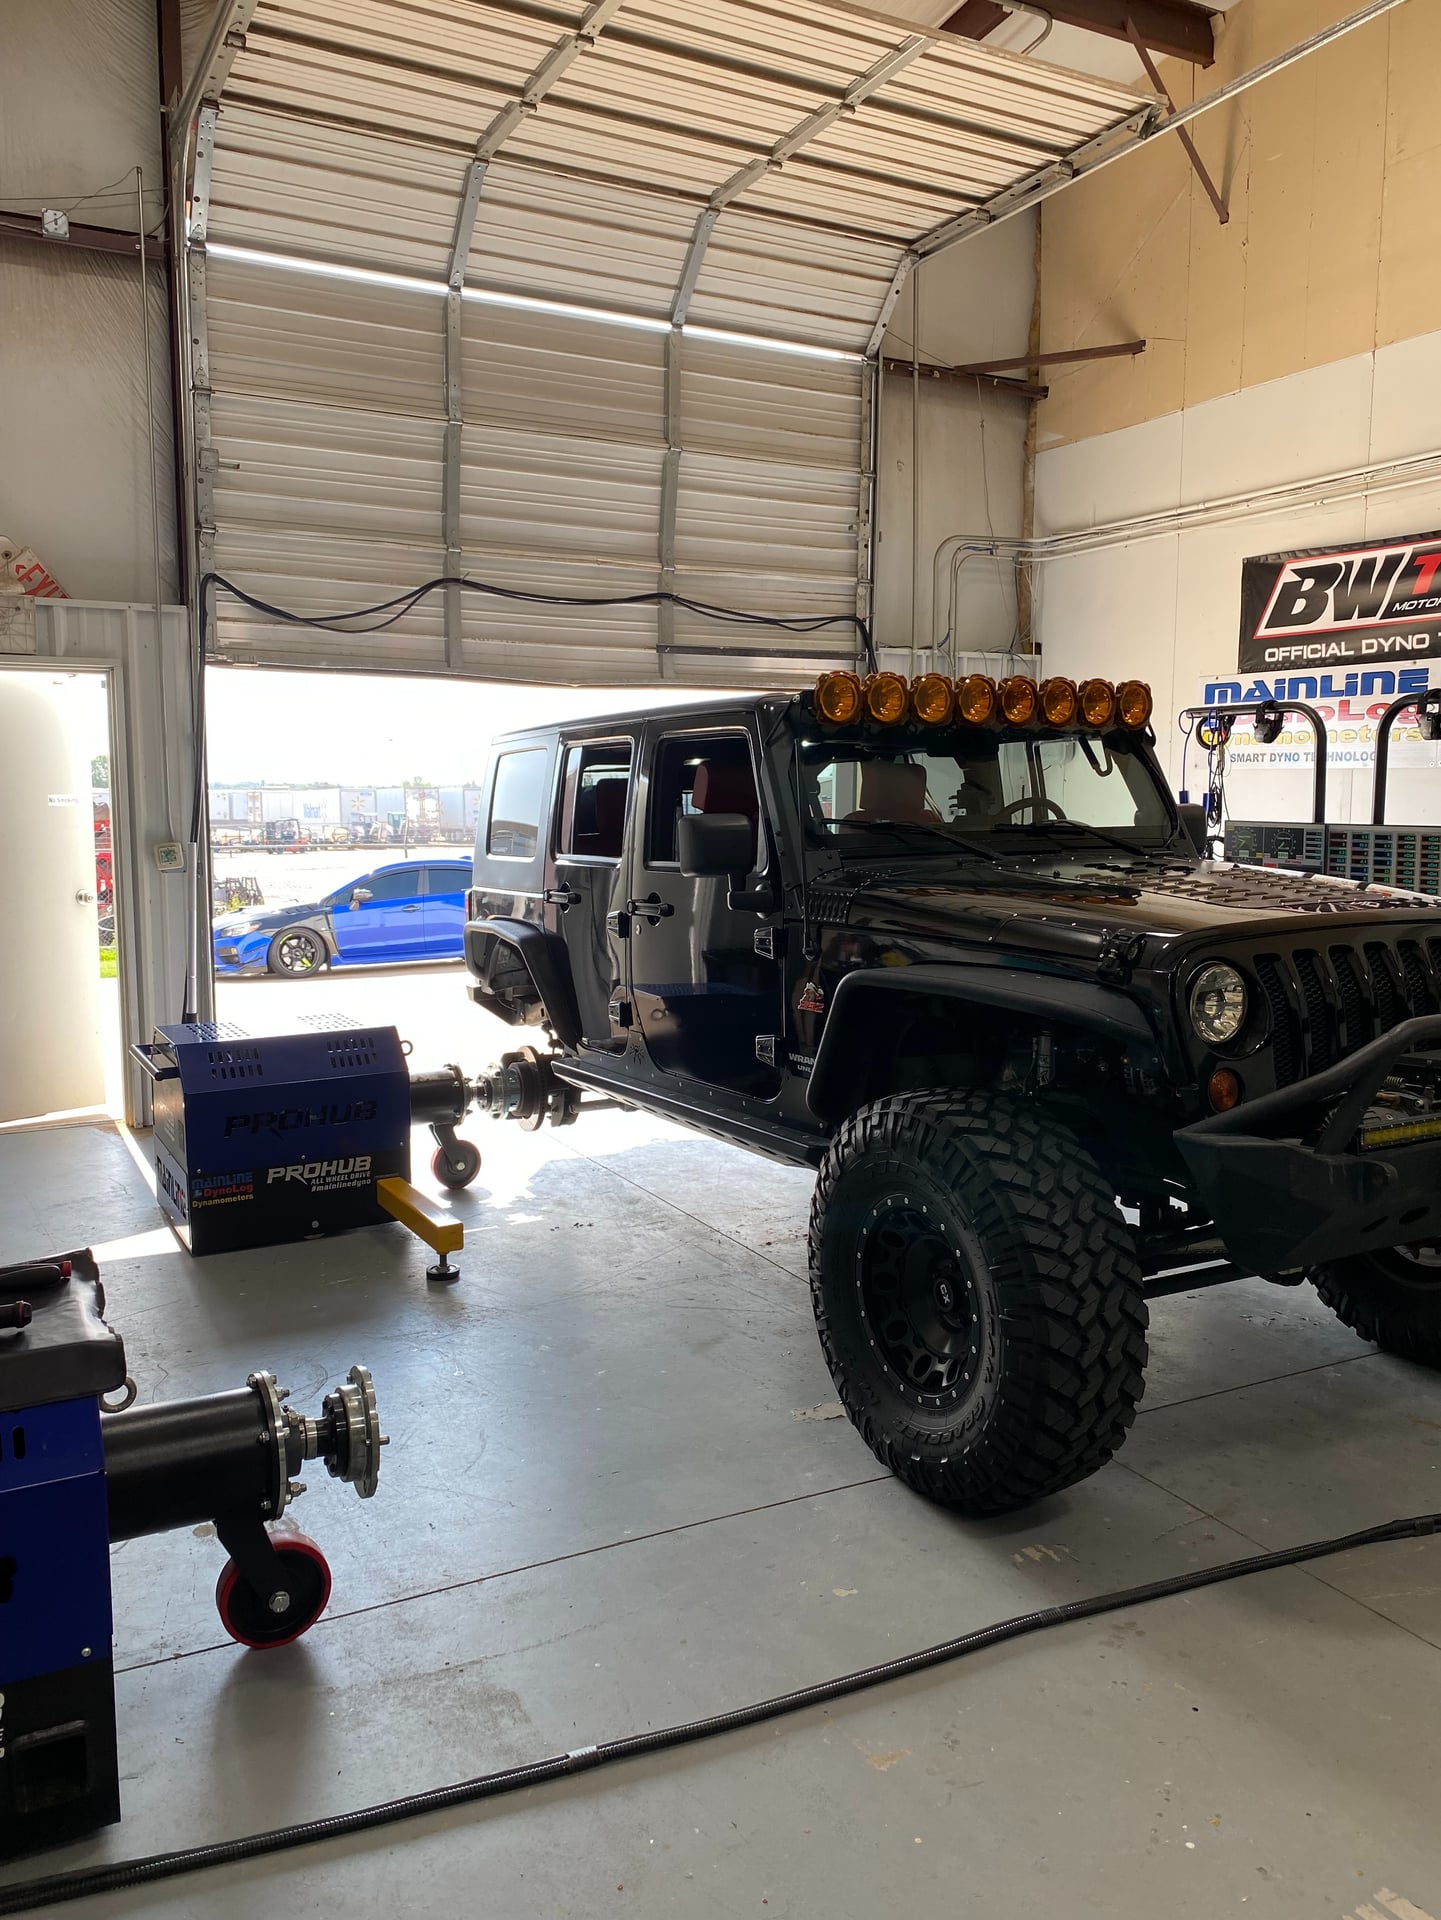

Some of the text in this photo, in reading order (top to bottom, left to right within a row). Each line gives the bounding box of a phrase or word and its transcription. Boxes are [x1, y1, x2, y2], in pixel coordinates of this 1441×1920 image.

[1264, 633, 1430, 662] OFFICIAL DYNO
[1230, 752, 1266, 763] SMART
[1269, 751, 1300, 762] DYNO
[224, 1101, 377, 1140] PROHUB
[266, 1156, 371, 1185] PROHUB
[326, 1174, 349, 1183] WHEEL
[350, 1171, 371, 1180] DRIVE
[204, 1184, 254, 1199] DynoLog
[311, 1179, 371, 1192] #mainlinedyno
[192, 1194, 254, 1208] Dynamometers
